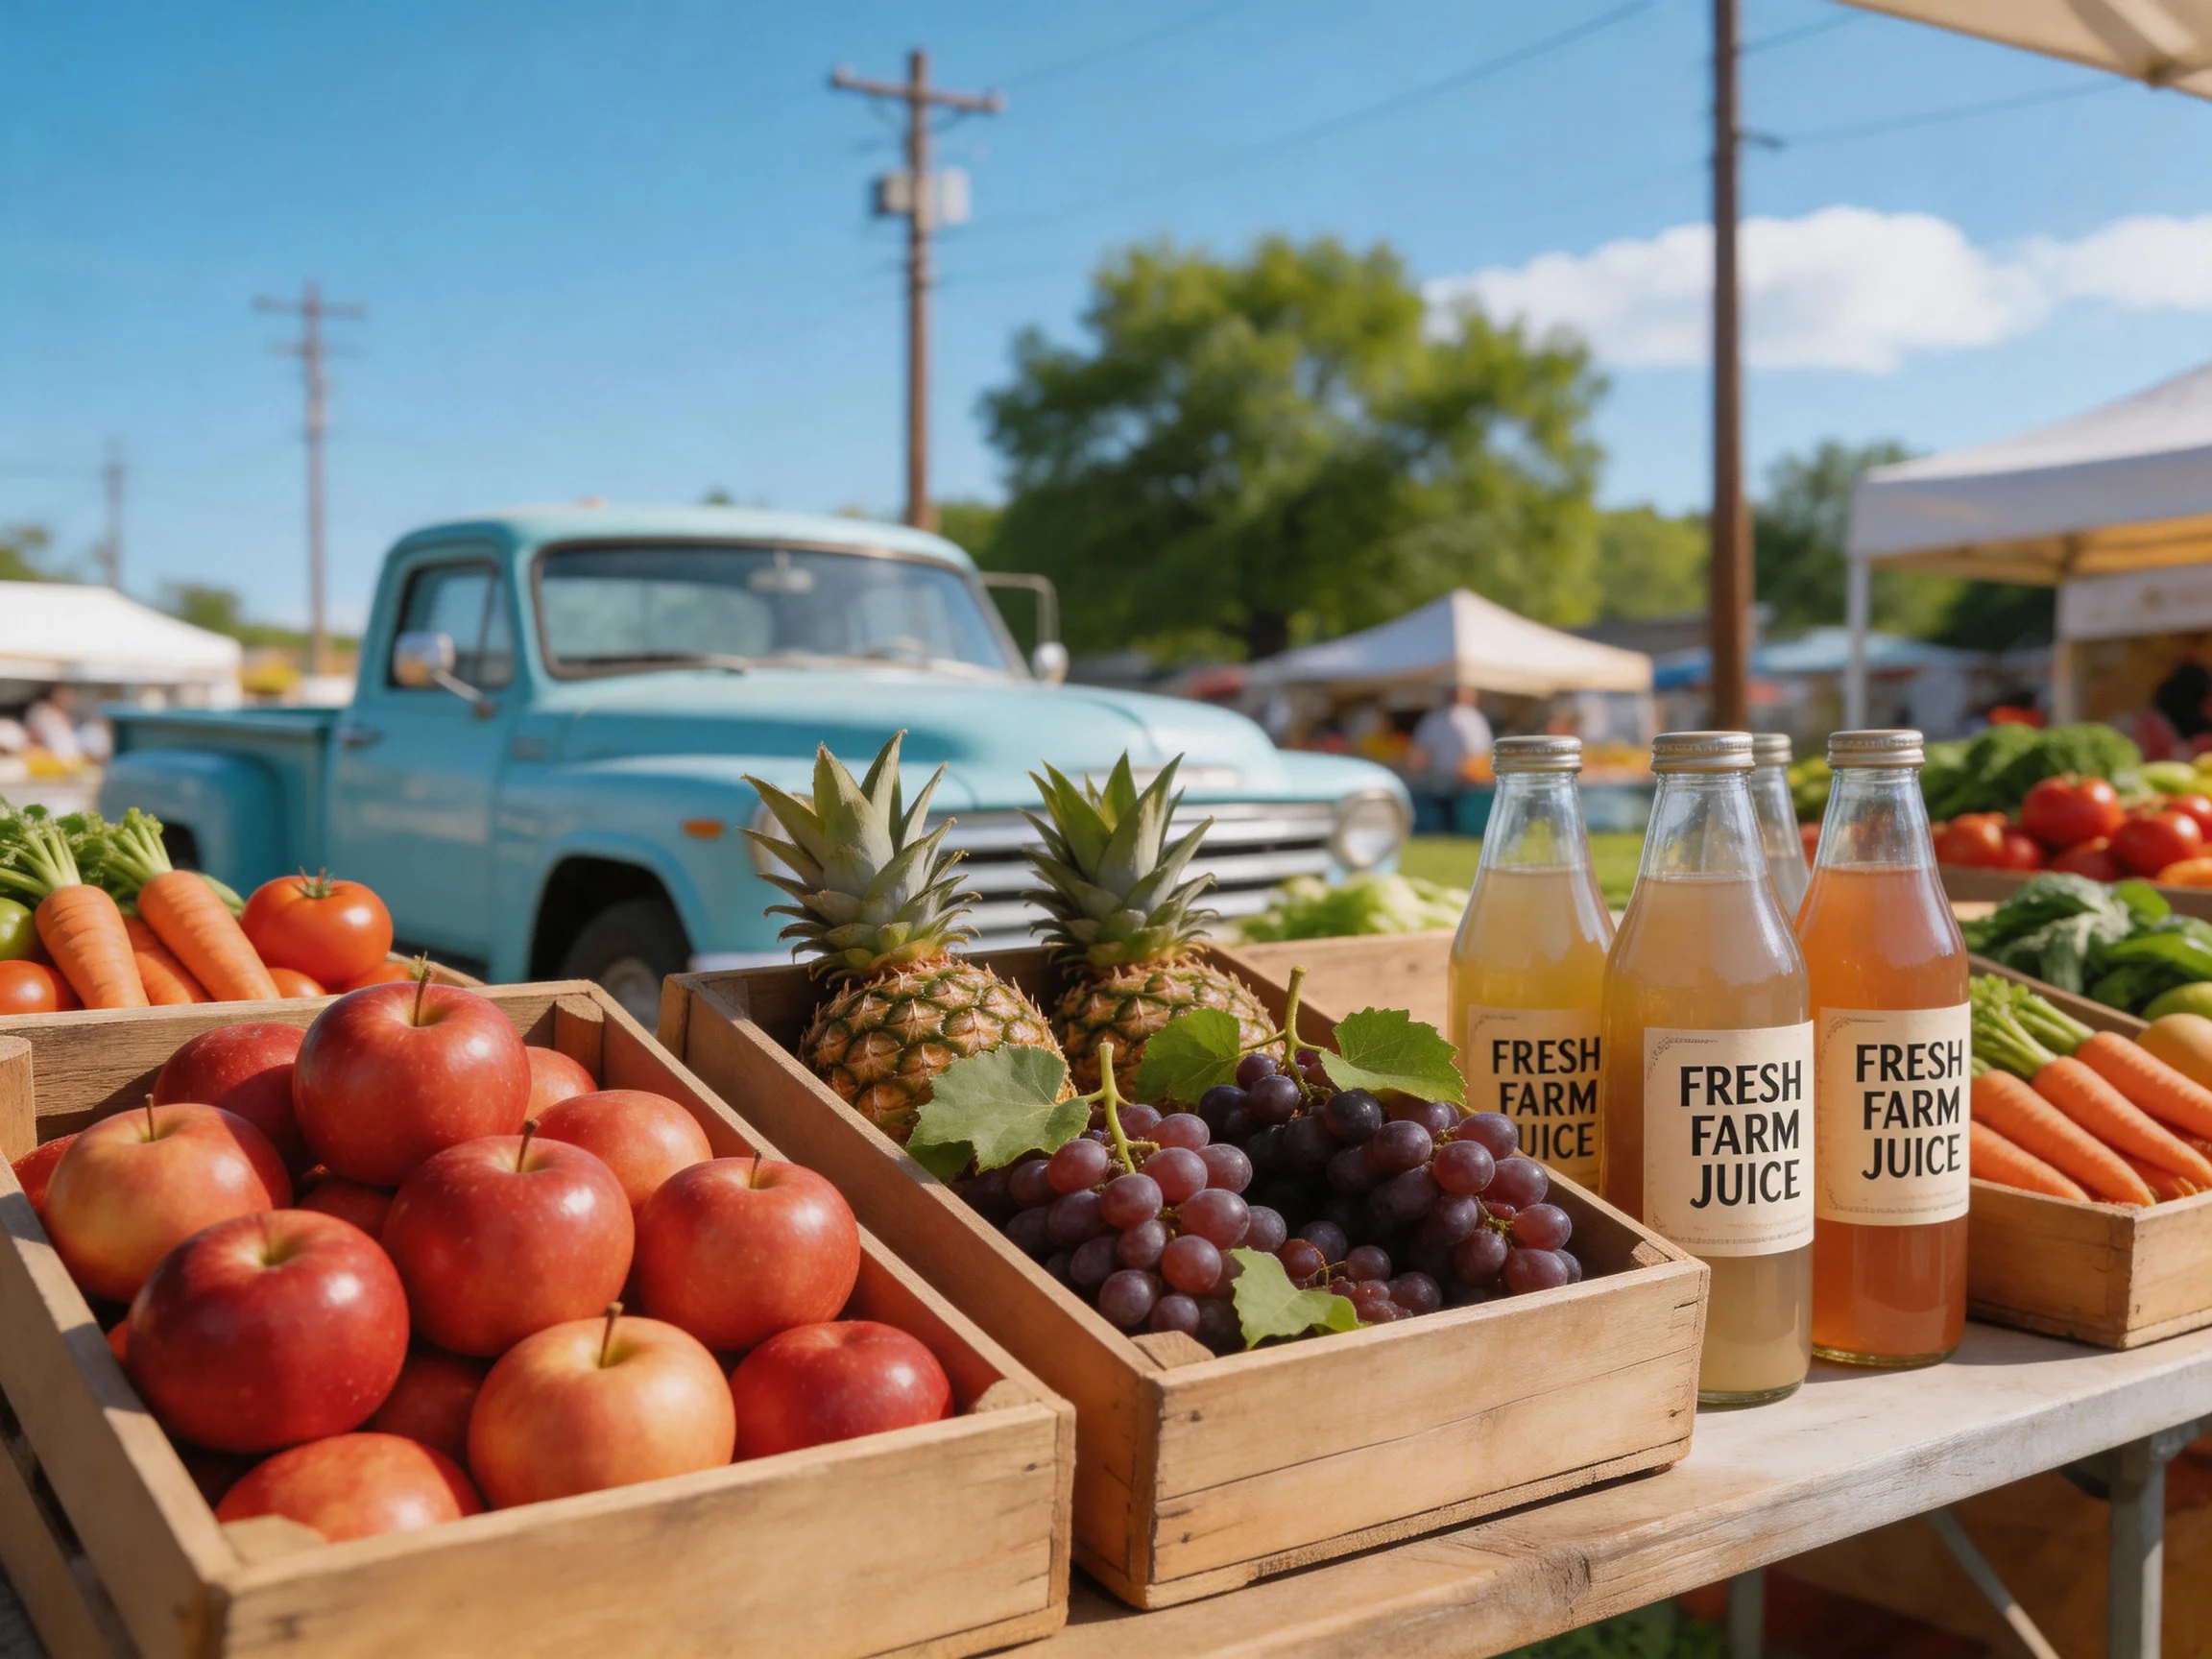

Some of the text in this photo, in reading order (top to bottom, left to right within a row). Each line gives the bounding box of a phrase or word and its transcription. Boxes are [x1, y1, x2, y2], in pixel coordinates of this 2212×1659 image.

[1492, 1037, 1601, 1074] FRESH
[1856, 1039, 1963, 1083] FRESH
[1500, 1079, 1598, 1117] FARM
[1680, 1060, 1802, 1107] FRESH
[1863, 1086, 1960, 1130] FARM
[1518, 1122, 1595, 1161] UICE
[1691, 1109, 1799, 1156] FARM
[1862, 1133, 1961, 1180] JUICE
[1690, 1159, 1801, 1210] JUICE
